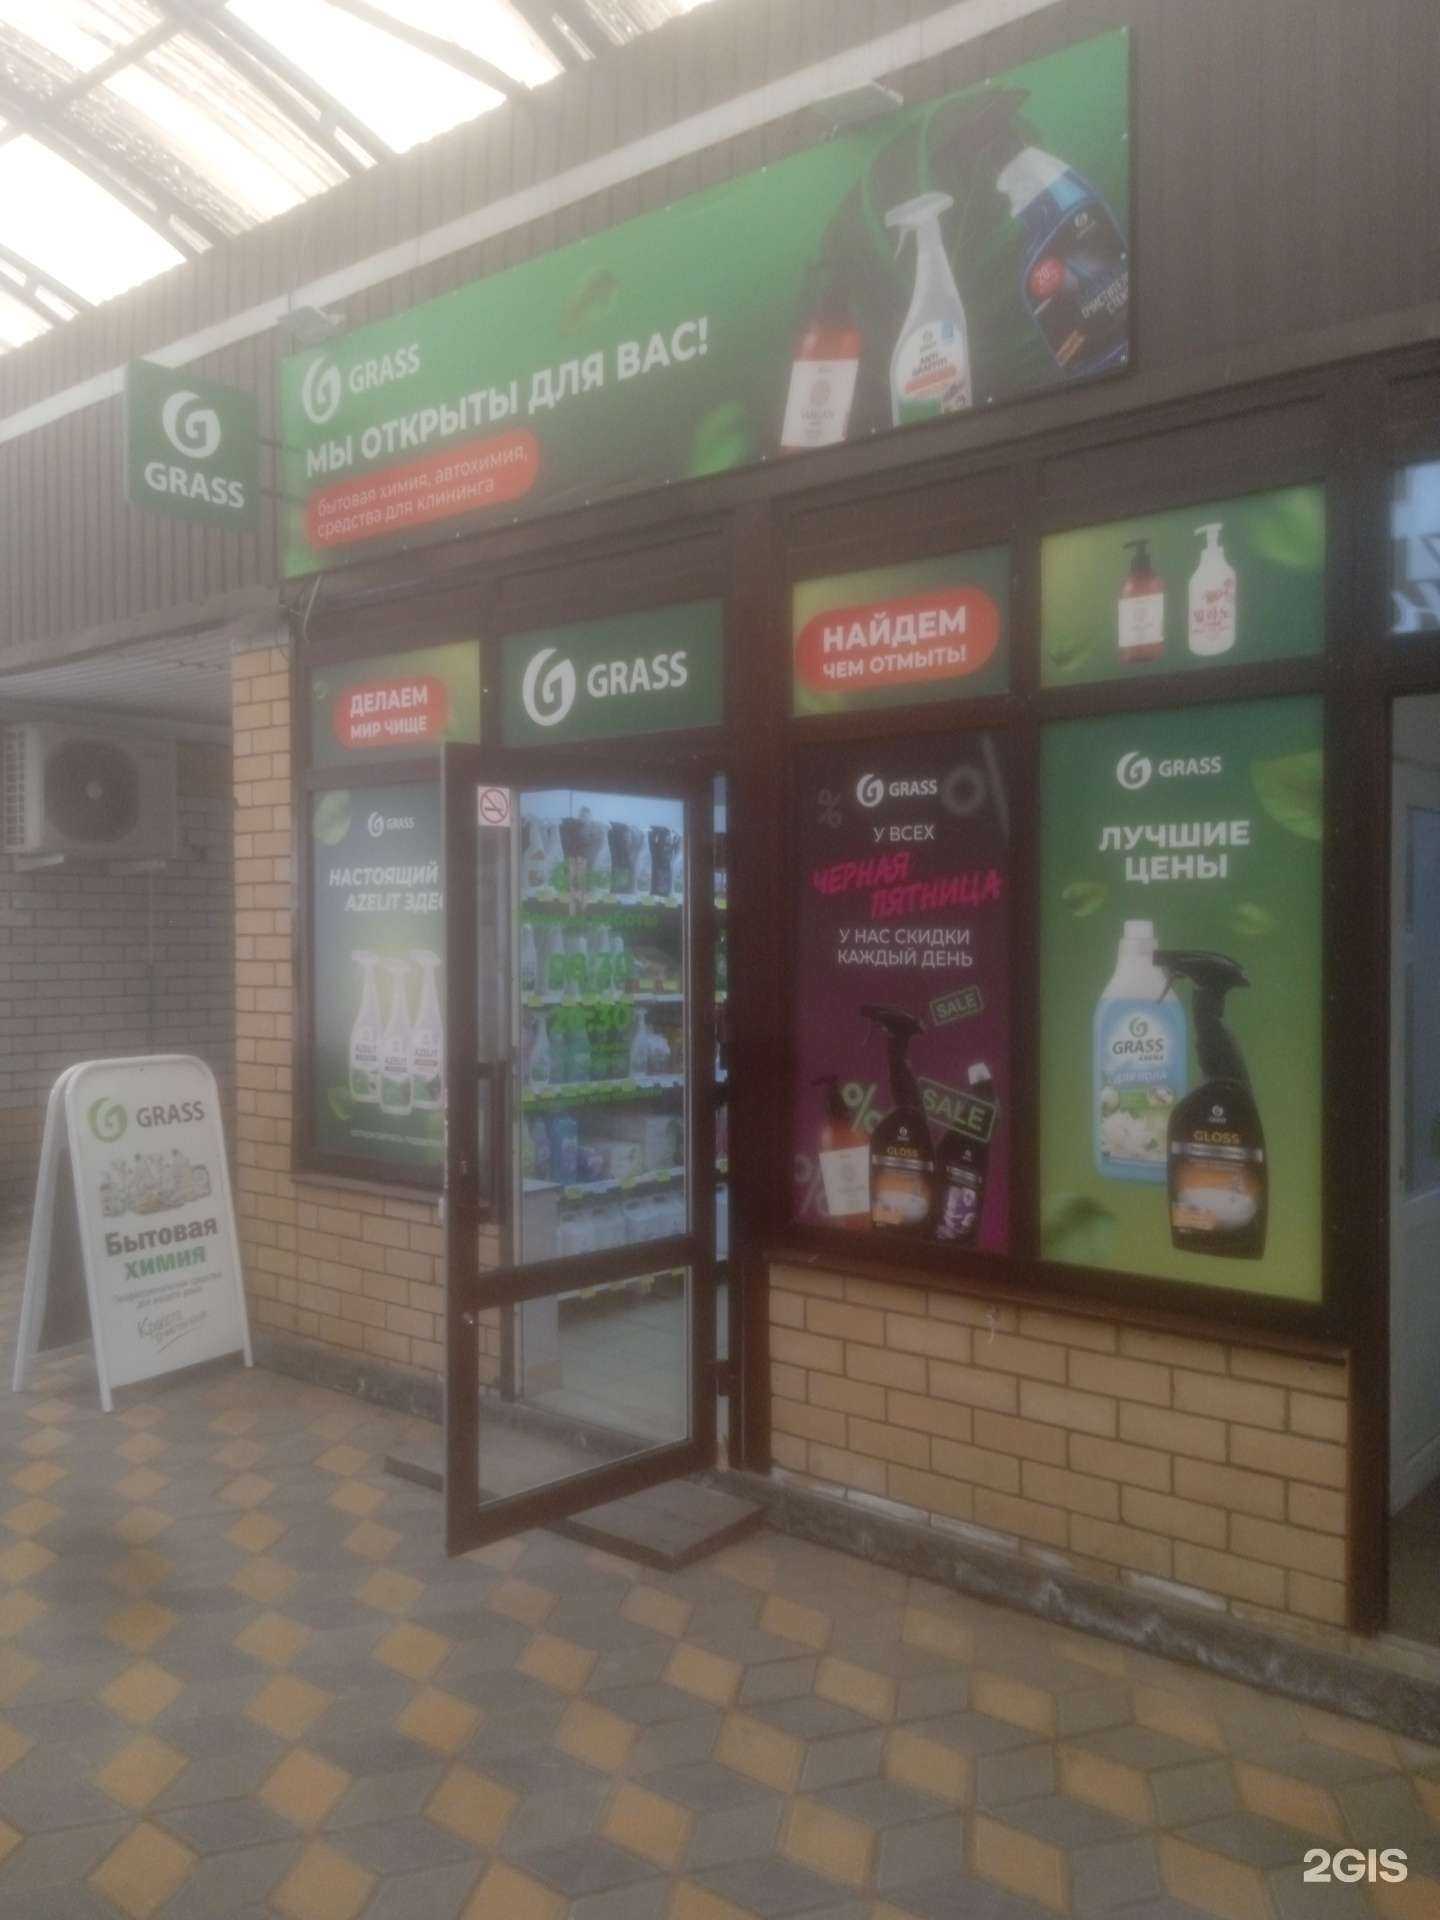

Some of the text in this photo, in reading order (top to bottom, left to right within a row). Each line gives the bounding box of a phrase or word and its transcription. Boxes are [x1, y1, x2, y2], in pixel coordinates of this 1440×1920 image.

[349, 344, 421, 394] GRASS
[305, 316, 708, 478] МЫ ОТКРЫТЫ ДЛЯ ВАС!
[144, 462, 245, 508] GRASS
[317, 445, 529, 518] бытовая химия, автохимия,
[317, 478, 495, 541] средства для клининга
[823, 606, 967, 653] НАЙДЕМ
[586, 651, 688, 699] GRASS
[823, 645, 966, 679] ЧЕМ ОТМЫТЬ!
[350, 685, 428, 718] ДЕЛАЕМ
[350, 715, 428, 740] МИР ЧИЩЕ
[1158, 756, 1222, 777] GRASS
[889, 780, 937, 798] GRASS
[385, 815, 416, 830] GRASS
[873, 825, 935, 843] У ВСЕХ
[1099, 820, 1250, 851] ЛУЧШИЕ
[329, 859, 439, 888] НАСТОЯЩИЙ
[1125, 854, 1227, 884] ЦЕНЫ
[840, 928, 970, 947] У НАС СКИДКИ
[838, 948, 973, 968] КАЖДЫЙ ДЕНЬ
[936, 992, 978, 1018] SALE
[1112, 1038, 1164, 1055] GRASS
[136, 1101, 205, 1128] GRASS
[922, 1089, 987, 1132] SALE
[105, 1217, 218, 1257] Бытовая
